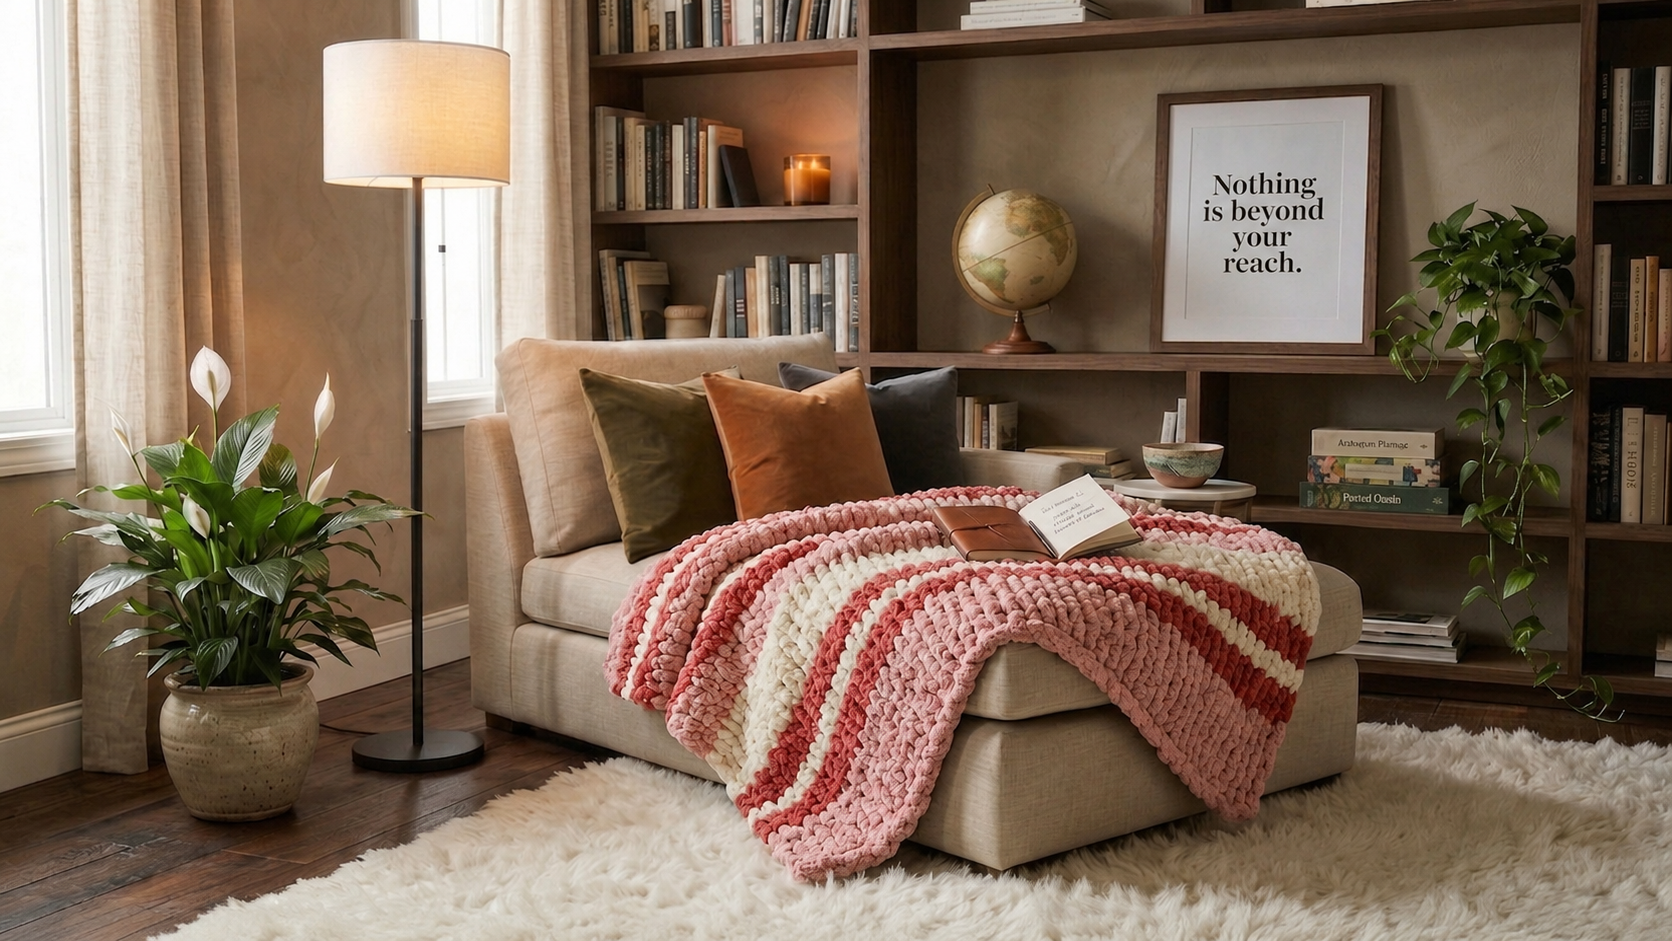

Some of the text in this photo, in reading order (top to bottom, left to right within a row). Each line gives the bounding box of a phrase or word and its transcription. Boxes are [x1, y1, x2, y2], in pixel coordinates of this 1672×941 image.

[1212, 171, 1317, 200] Nothing
[1203, 197, 1324, 227] is beyond
[1232, 230, 1292, 253] your
[1223, 251, 1302, 273] reach.
